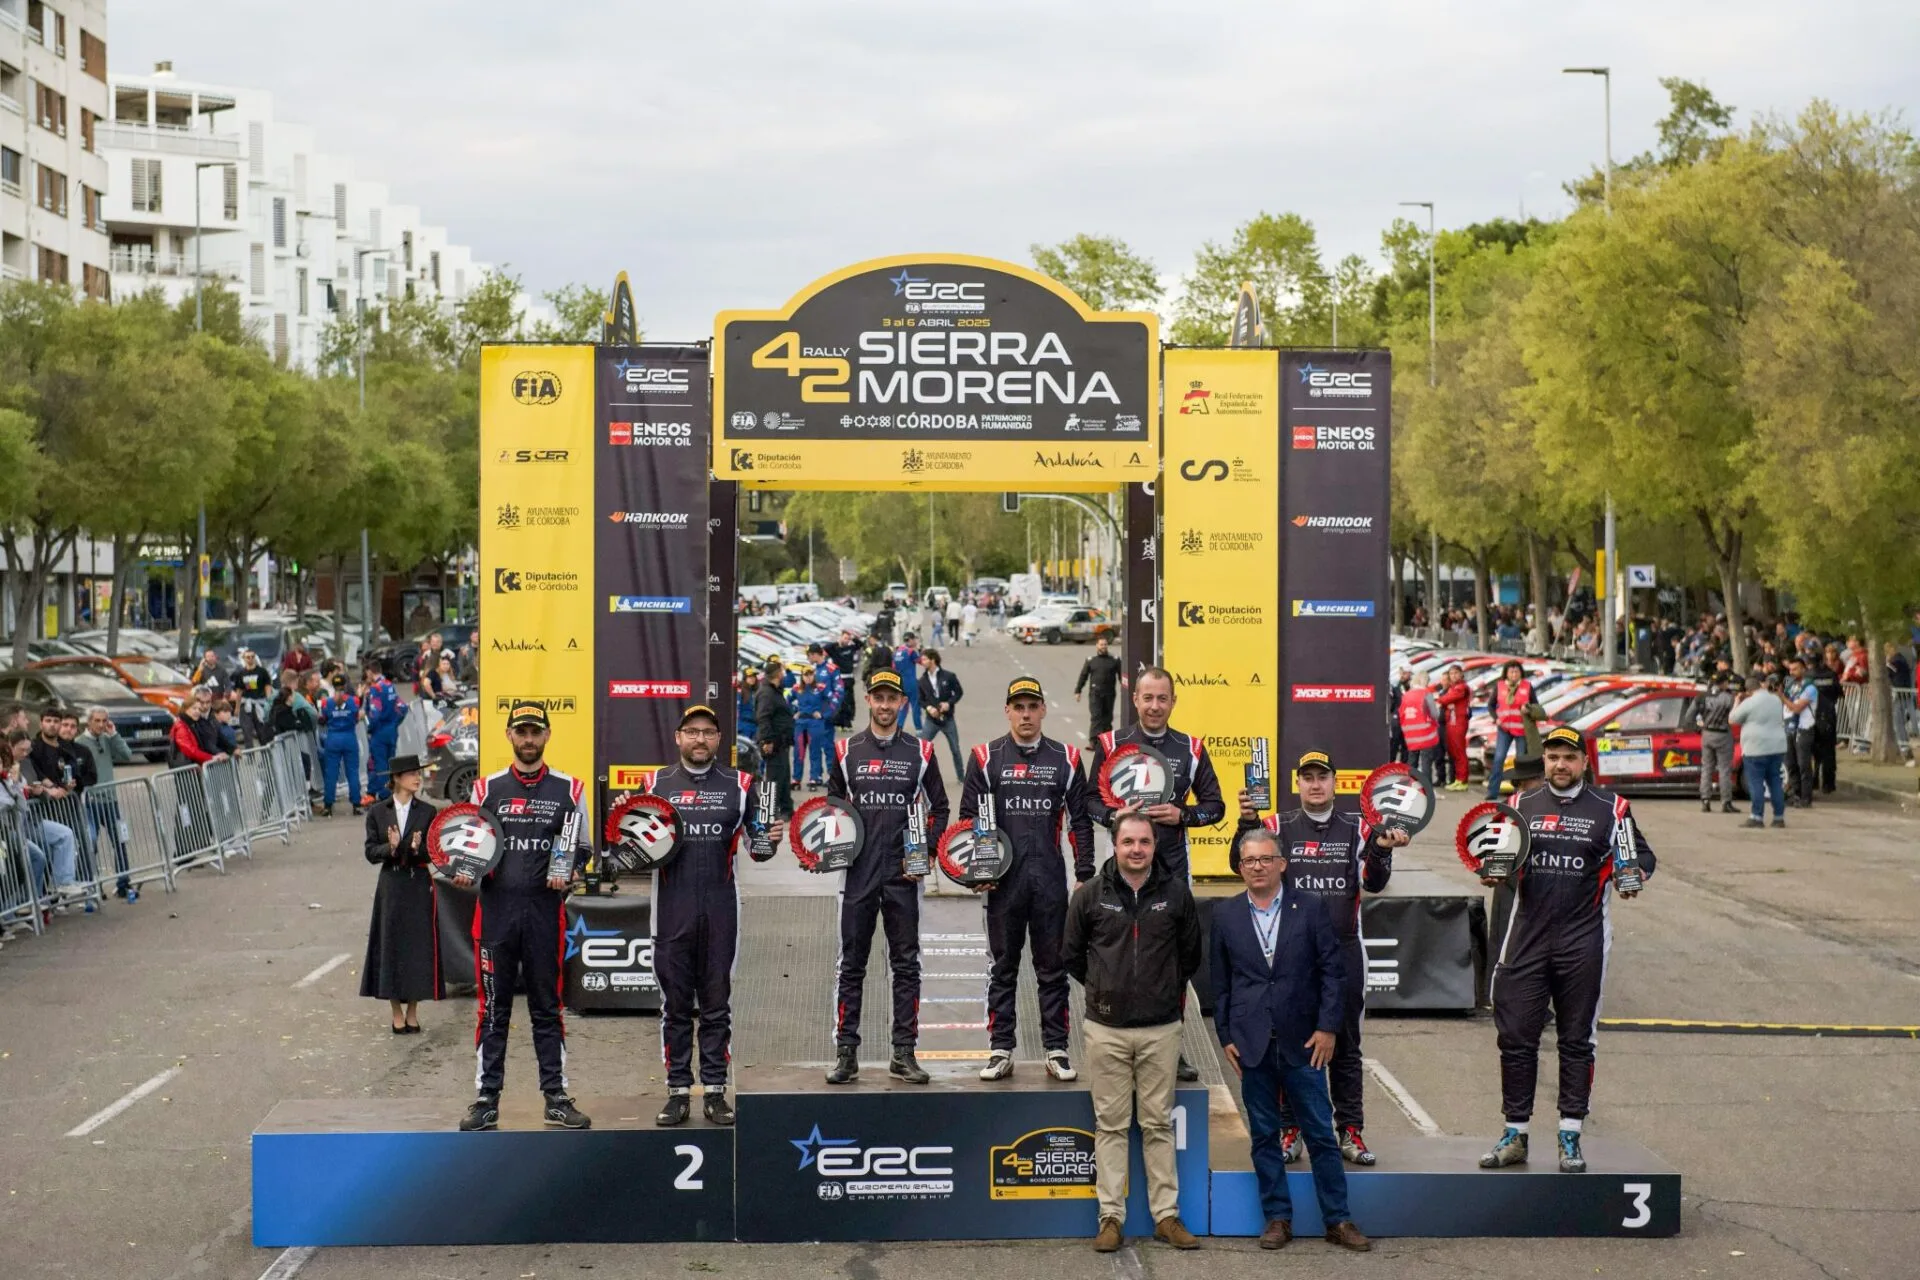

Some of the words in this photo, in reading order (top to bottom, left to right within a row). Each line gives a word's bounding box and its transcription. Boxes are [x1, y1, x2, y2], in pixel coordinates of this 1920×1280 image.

[905, 283, 985, 300] ERC
[882, 319, 891, 327] 3
[894, 318, 904, 327] al
[907, 319, 916, 327] 6
[918, 319, 955, 327] ABRIL
[957, 319, 991, 327] 2025
[803, 347, 850, 357] RALLY
[859, 331, 1073, 365] SIERRA
[752, 331, 851, 403] 42
[626, 368, 689, 383] ERC
[1309, 373, 1372, 387] ERC
[859, 370, 1121, 404] MORENA
[1214, 392, 1228, 400] Real
[1229, 391, 1263, 400] Federación
[896, 412, 979, 428] CÓRDOBA
[633, 422, 692, 436] ENEOS
[1317, 427, 1375, 440] ENEOS
[633, 438, 671, 446] MOTOR
[675, 438, 692, 446] OIL
[1317, 441, 1355, 450] MOTOR
[1358, 441, 1375, 450] OIL
[757, 453, 802, 462] Diputación
[925, 452, 972, 460] AYUNTAMIENTO
[925, 461, 933, 469] DE
[527, 507, 580, 516] AYUNTAMIENTO
[526, 517, 535, 526] DE
[1209, 533, 1263, 541] AYUNTAMIENTO
[1209, 543, 1218, 551] DE
[525, 571, 578, 582] Diputación
[525, 583, 537, 591] de
[538, 582, 579, 591] Córdoba
[631, 601, 685, 609] MICHELIN
[1316, 605, 1368, 613] MICHELIN
[1209, 605, 1262, 616] Diputación
[1209, 617, 1219, 625] de
[1222, 615, 1263, 625] Córdoba
[611, 683, 650, 694] MRF
[651, 683, 688, 694] TYRES
[1294, 688, 1333, 698] MRF
[1334, 688, 1372, 698] TYRES
[1208, 736, 1261, 748] PEGASU
[1208, 749, 1232, 757] AERO
[1233, 749, 1252, 757] GRO
[857, 765, 881, 773] GR
[1002, 769, 1026, 778] GR
[670, 795, 694, 804] GR
[498, 803, 524, 815] GR
[535, 817, 553, 825] Cup
[1530, 820, 1557, 831] GR
[1561, 816, 1595, 824] TOYOTA
[683, 821, 723, 835] iNTO
[1292, 846, 1317, 856] GR
[1170, 1105, 1187, 1150] 1
[817, 1146, 953, 1176] ERC
[1002, 1153, 1033, 1175] 42
[673, 1144, 704, 1190] 2
[1035, 1163, 1097, 1175] MOREN
[1621, 1182, 1652, 1228] 3
